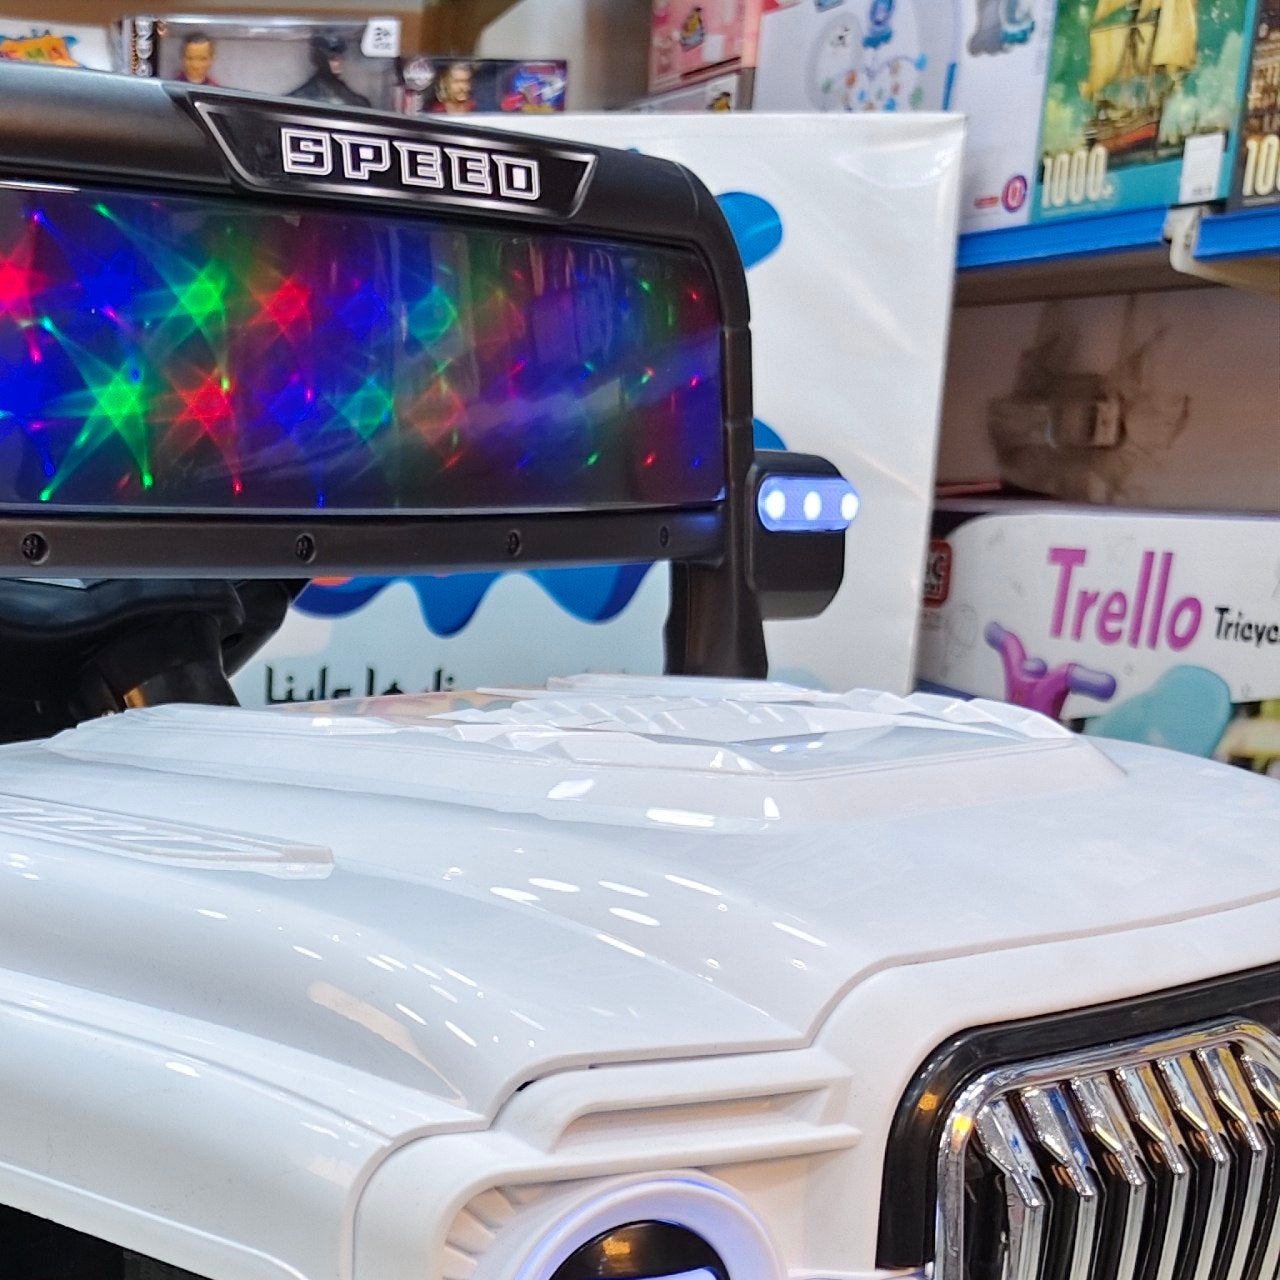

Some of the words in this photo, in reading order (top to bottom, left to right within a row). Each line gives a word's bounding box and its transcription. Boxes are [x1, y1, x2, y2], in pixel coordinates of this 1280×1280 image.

[279, 126, 542, 201] SPEED
[1041, 144, 1108, 208] 1000
[1047, 546, 1203, 651] Trello
